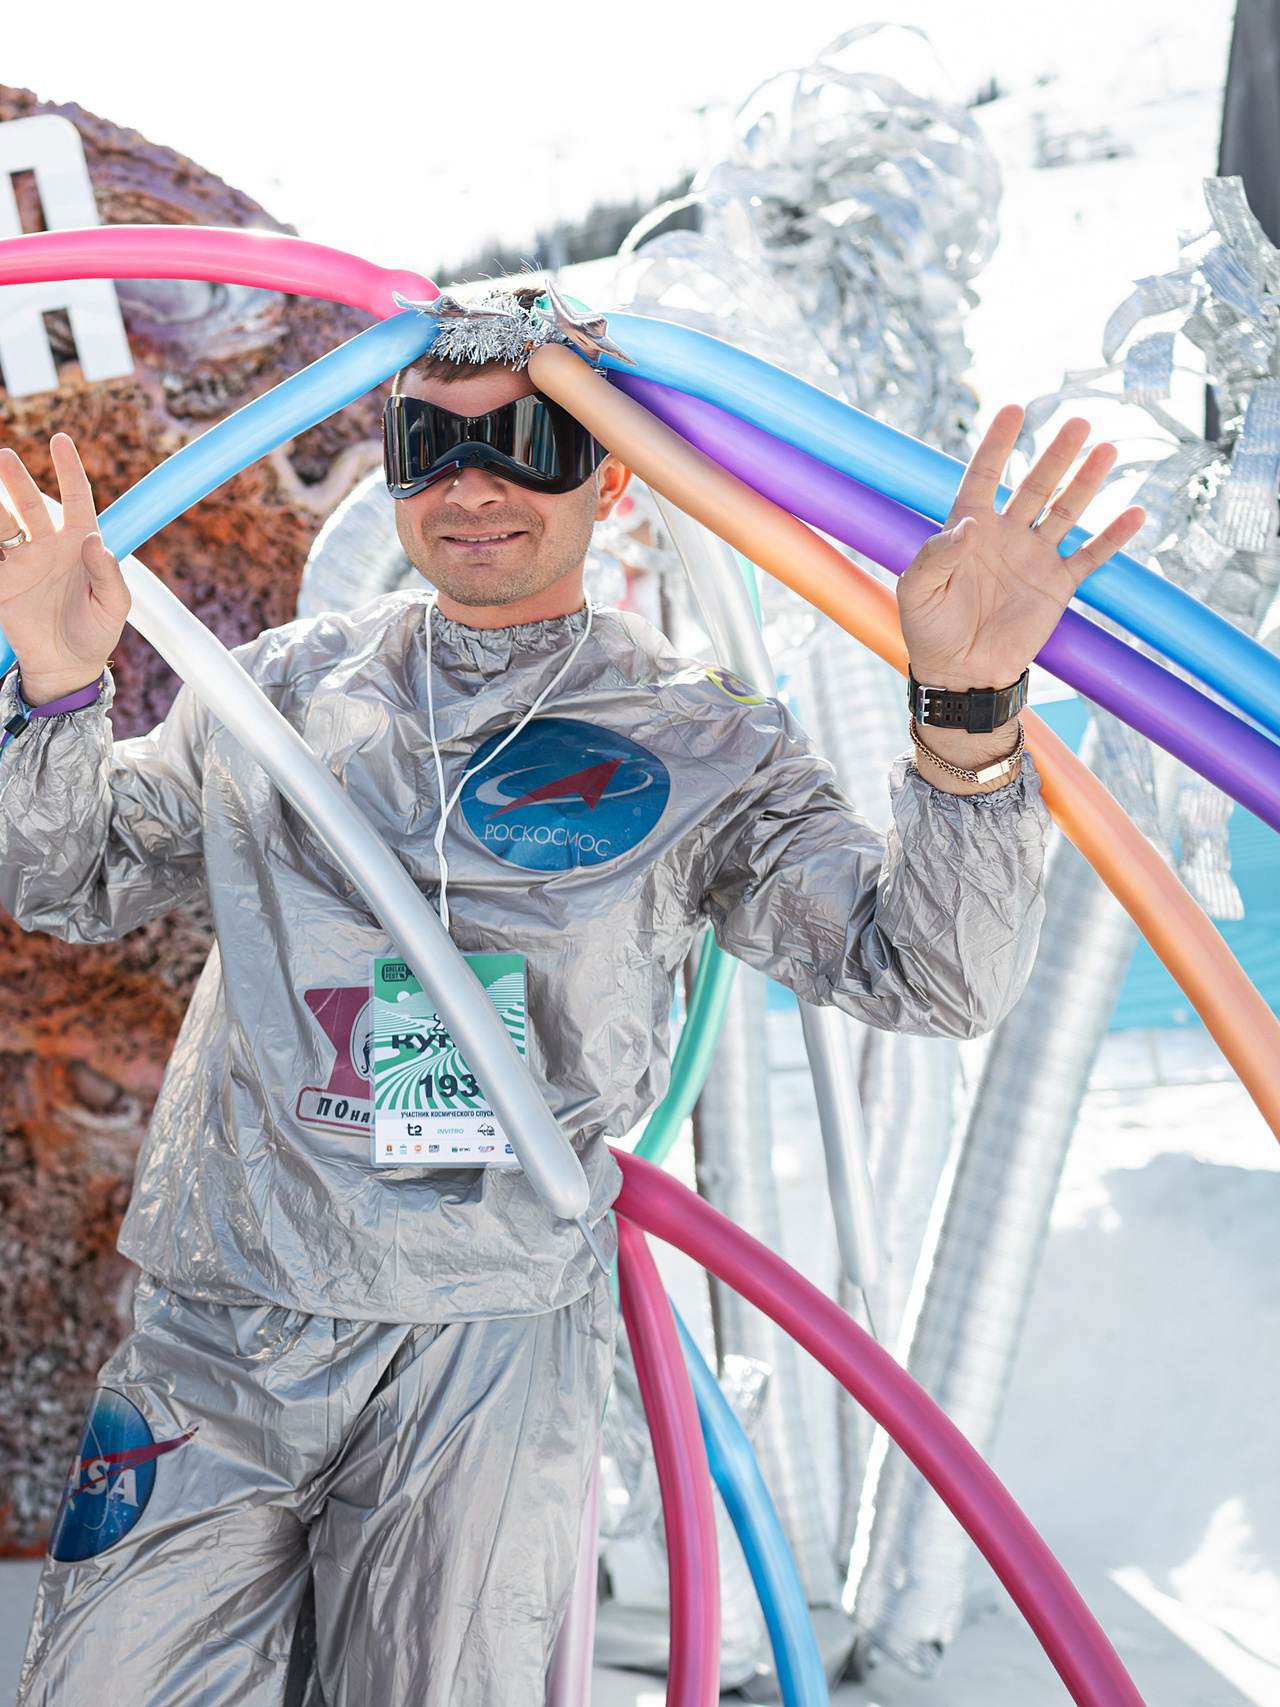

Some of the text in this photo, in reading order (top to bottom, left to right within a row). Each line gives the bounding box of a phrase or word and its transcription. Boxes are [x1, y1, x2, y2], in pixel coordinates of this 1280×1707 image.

[484, 823, 611, 857] РОСКОСМОС
[391, 1034, 457, 1053] куп
[419, 1074, 480, 1098] 193
[400, 1110, 495, 1119] УЧАСТНИК КОСМИЧЕСКОГО СПУСК
[406, 1123, 423, 1136] t2
